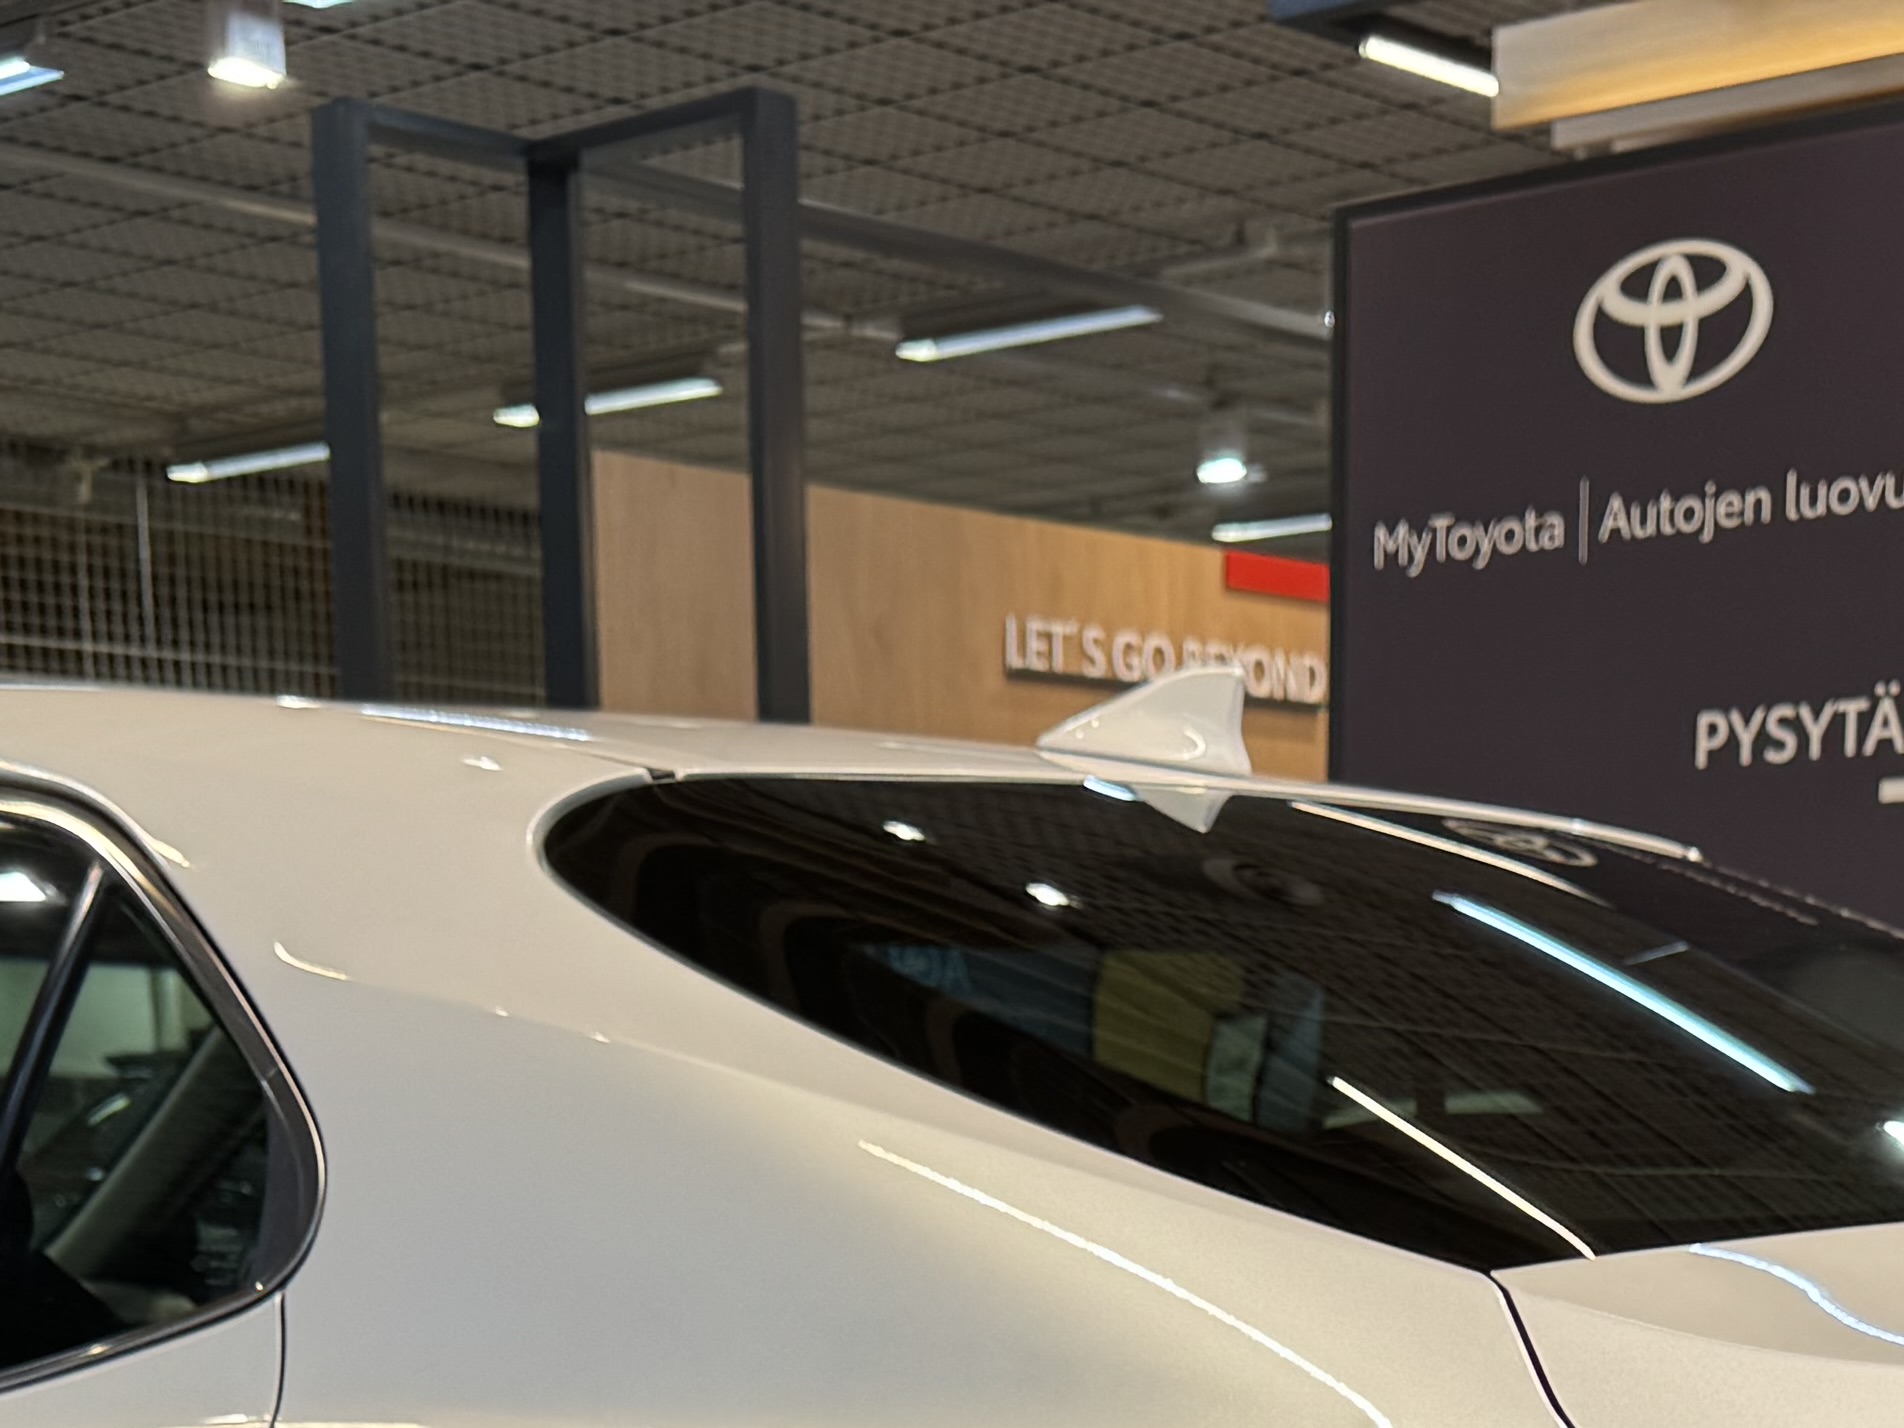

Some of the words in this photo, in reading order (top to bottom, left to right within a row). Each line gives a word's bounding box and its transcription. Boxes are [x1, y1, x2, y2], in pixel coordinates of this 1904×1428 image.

[1372, 506, 1566, 578] MyToyota
[1597, 480, 1772, 544] Autojen
[1112, 628, 1176, 683] GO
